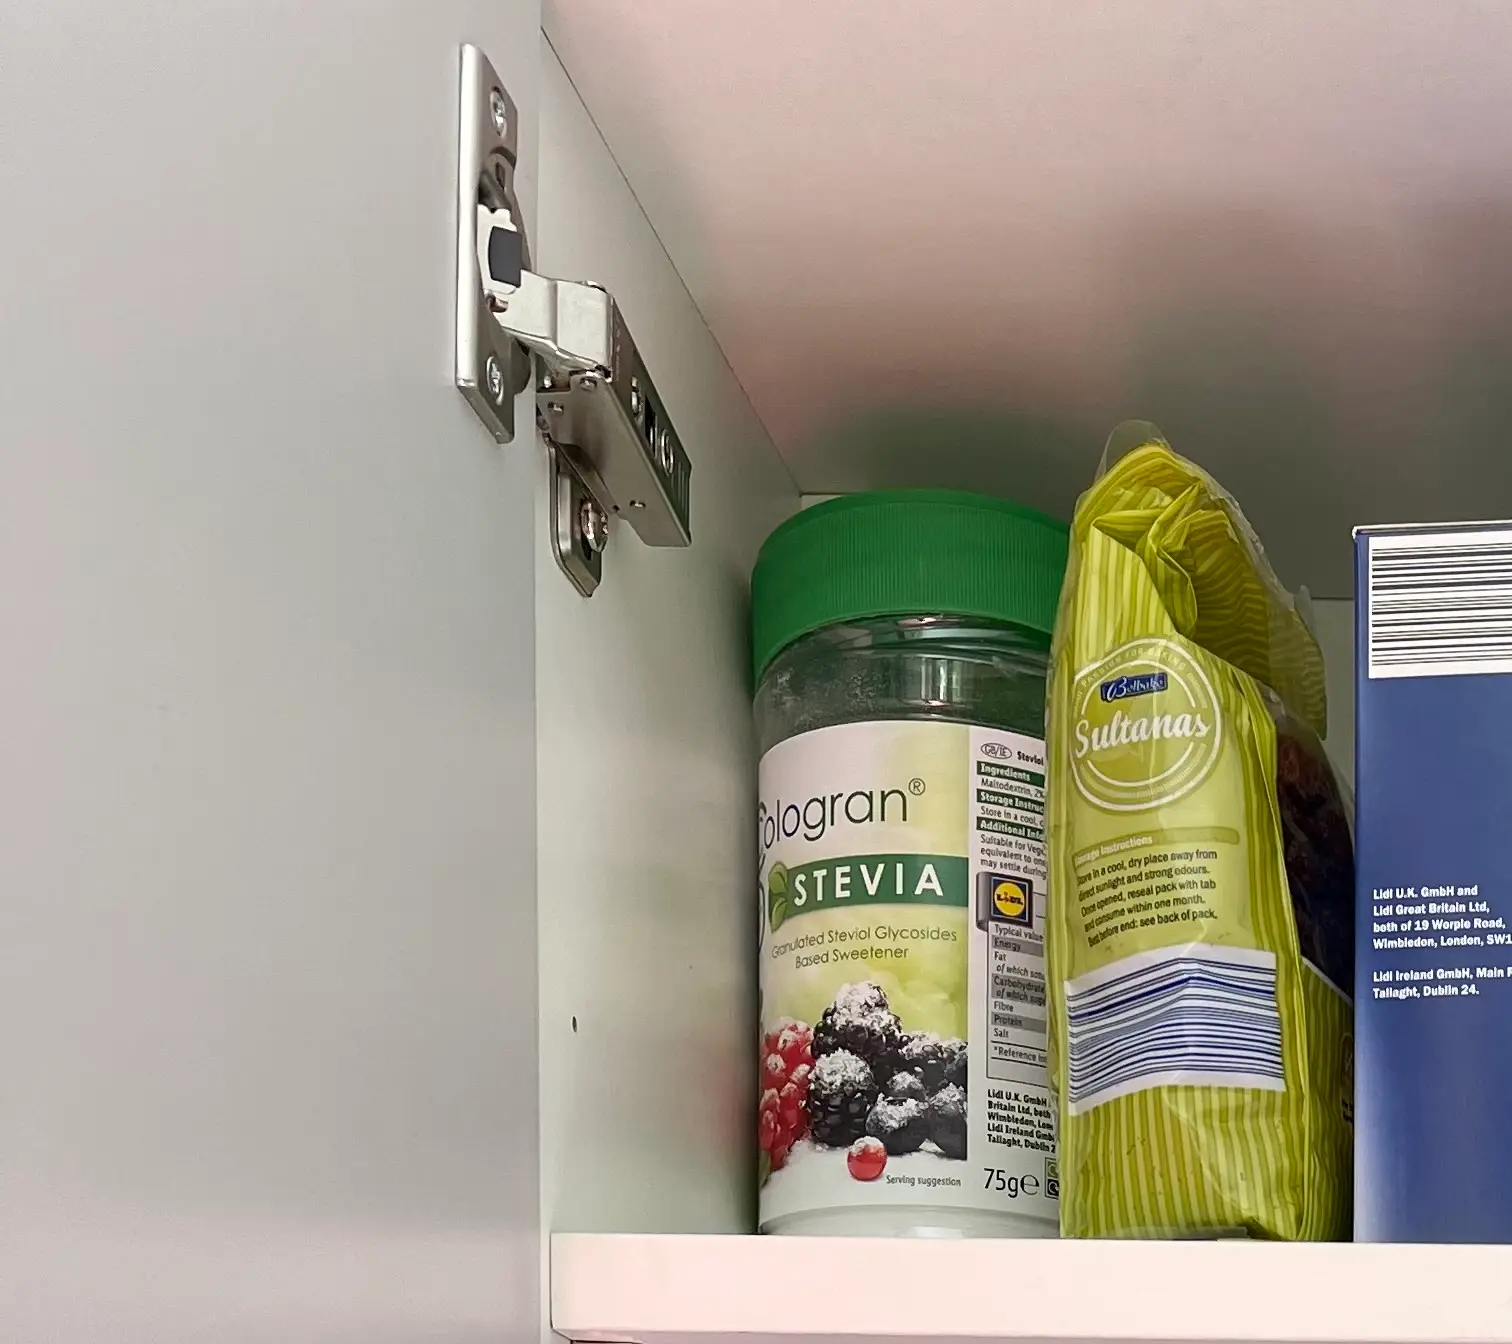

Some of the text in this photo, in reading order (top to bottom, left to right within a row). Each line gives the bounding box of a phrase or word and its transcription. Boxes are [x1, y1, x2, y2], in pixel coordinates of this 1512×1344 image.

[1075, 710, 1212, 758] Sultanas
[981, 763, 1030, 781] Ingredients
[793, 863, 944, 907] STEVIA
[1373, 885, 1478, 900] Lidl U.K. GmbH and
[1373, 901, 1490, 916] Lidl Great Britain Ltd,
[1373, 921, 1398, 932] both
[1401, 920, 1412, 931] of
[1414, 919, 1428, 931] 19
[1474, 917, 1505, 929] Road,
[828, 927, 871, 944] Steviol
[875, 926, 957, 942] Glycosides
[1373, 937, 1437, 950] Wimbledon,
[1441, 936, 1484, 948] London,
[796, 947, 908, 969] Based Sweetener
[1373, 971, 1393, 982] Lidl
[1396, 969, 1434, 981] Ireland
[1437, 968, 1473, 981] GmbH,
[1476, 968, 1504, 979] Main
[1373, 984, 1479, 1000] Tallaght, Dublin 24.
[886, 1175, 961, 1187] Serving suggestion
